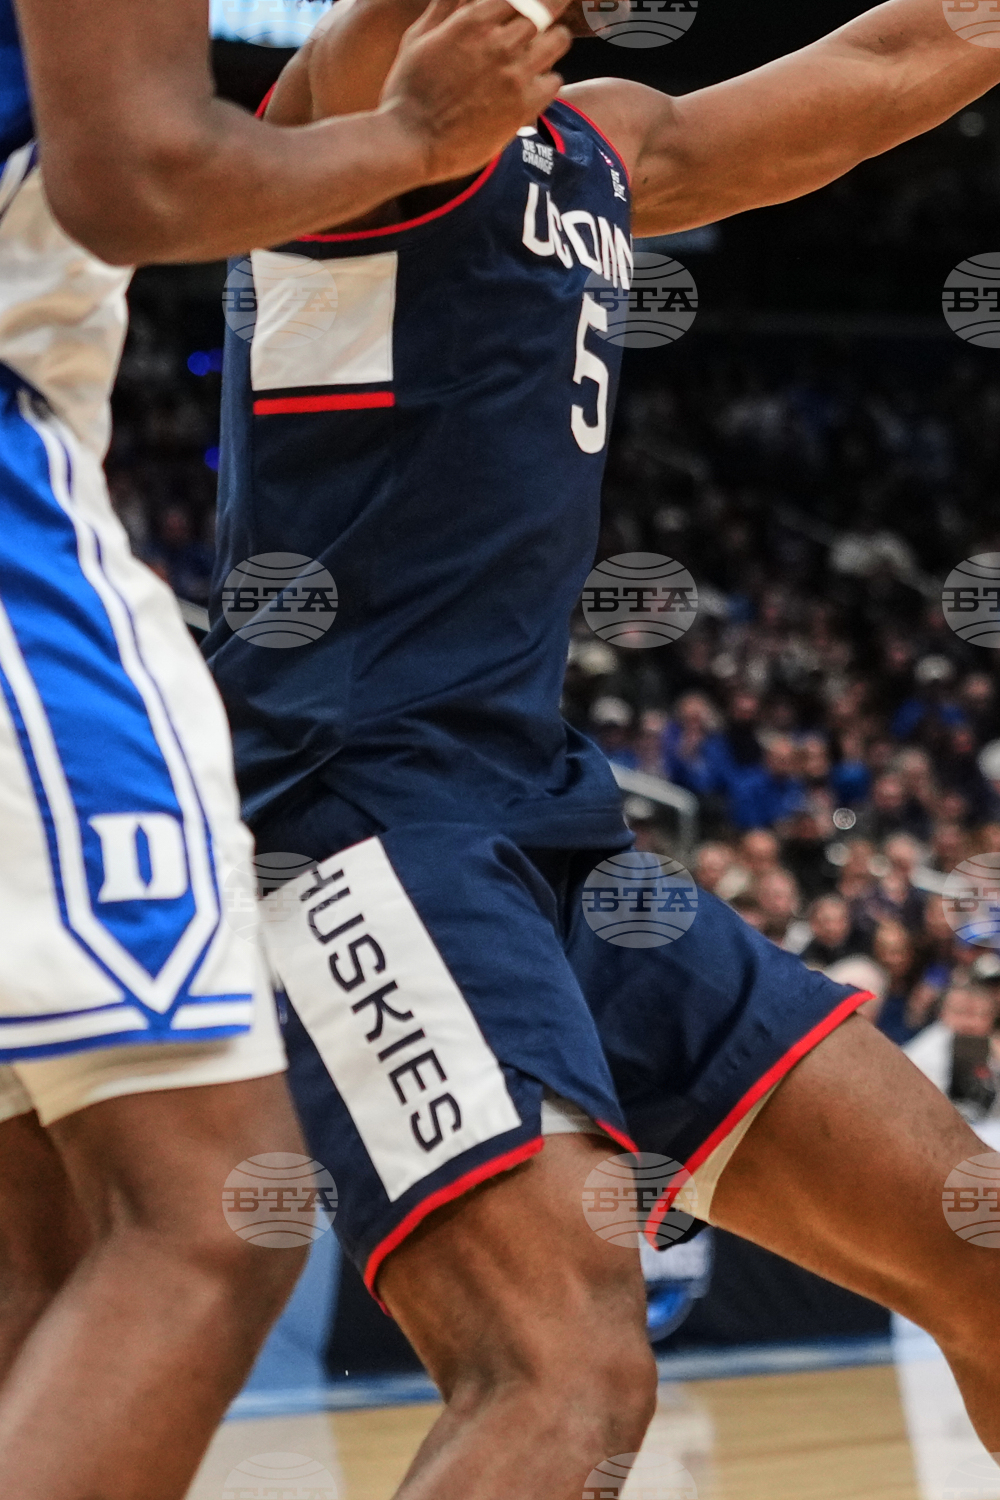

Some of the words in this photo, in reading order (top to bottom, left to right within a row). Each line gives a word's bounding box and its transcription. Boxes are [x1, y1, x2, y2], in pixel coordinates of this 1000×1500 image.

[521, 138, 536, 153] BE
[535, 143, 554, 161] THE
[522, 149, 554, 176] CHANGE
[522, 182, 634, 291] UCONN
[571, 292, 609, 454] 5
[88, 812, 188, 903] D
[299, 868, 463, 1154] HUSKIES
